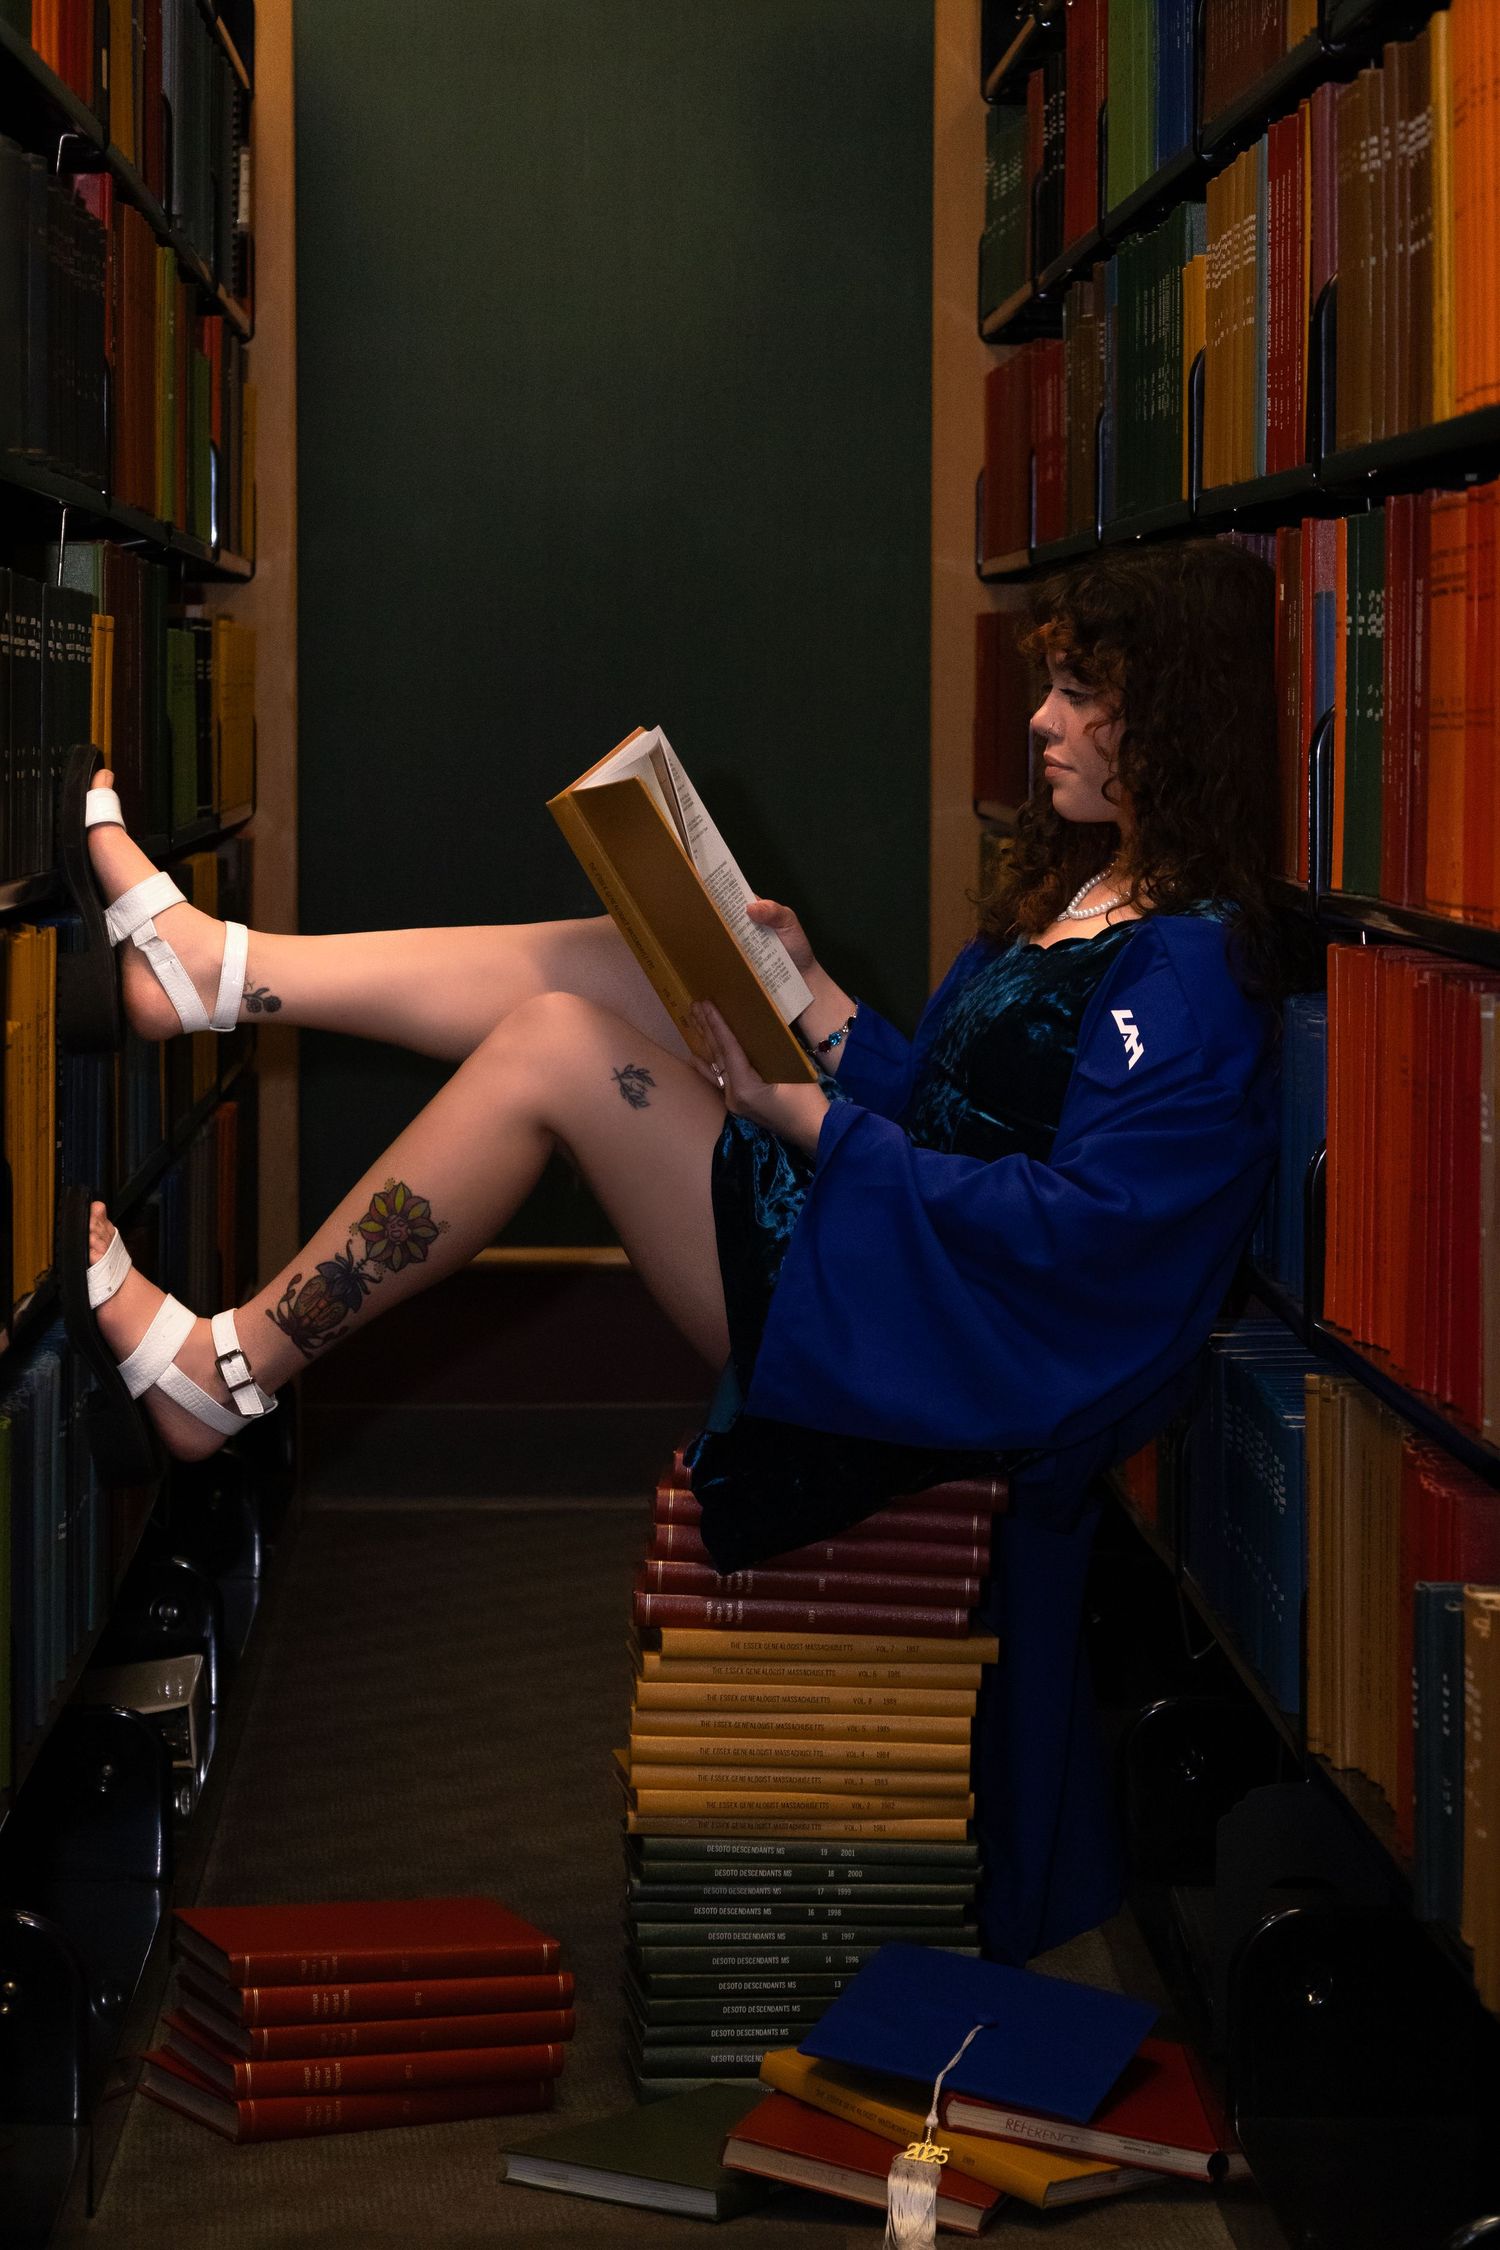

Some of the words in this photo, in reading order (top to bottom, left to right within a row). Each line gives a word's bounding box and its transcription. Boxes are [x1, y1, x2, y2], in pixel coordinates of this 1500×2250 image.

[731, 1642, 742, 1650] THE
[744, 1642, 762, 1650] ESSEX
[764, 1642, 803, 1651] GENEALOGIST
[804, 1643, 853, 1652] MASSACHUSETTS
[713, 1667, 724, 1675] THE
[707, 1695, 718, 1703] THE
[720, 1695, 738, 1703] ESSEX
[740, 1695, 780, 1704] GENEALOGIST
[781, 1696, 829, 1705] MASSACHUSETTS
[701, 1720, 712, 1729] THE
[700, 1748, 711, 1756] THE
[713, 1748, 731, 1756] ESSEX
[733, 1748, 772, 1757] GENEALOGIST
[773, 1749, 822, 1758] MASSACHUSETTS
[698, 1775, 709, 1783] THE
[706, 1801, 717, 1809] THE
[719, 1801, 738, 1809] ESSEX
[739, 1801, 779, 1809] GENEALOGIST
[780, 1801, 829, 1809] MASSACHUSETTS
[707, 1844, 730, 1853] DESOTO
[732, 1845, 774, 1855] DESCENDANTS
[776, 1847, 785, 1855] MS
[715, 1869, 738, 1877] DESOTO
[739, 1869, 782, 1877] DESCENDANTS
[783, 1869, 792, 1878] MS
[704, 1887, 727, 1895] DESOTO
[728, 1887, 771, 1895] DESCENDANTS
[772, 1887, 781, 1895] MS
[694, 1907, 717, 1915] DESOTO
[719, 1907, 761, 1916] DESCENDANTS
[762, 1908, 772, 1916] MS
[708, 1932, 731, 1940] DESOTO
[733, 1932, 775, 1940] DESCENDANTS
[776, 1932, 786, 1940] MS
[712, 1957, 736, 1965] DESOTO
[737, 1956, 780, 1965] DESCENDANTS
[781, 1956, 790, 1964] MS
[719, 1982, 742, 1990] DESOTO
[743, 1981, 786, 1990] DESCENDANTS
[787, 1981, 796, 1989] MS
[723, 2005, 746, 2014] DESOTO
[748, 2005, 790, 2013] DESCENDANTS
[791, 2005, 800, 2013] MS
[711, 2029, 734, 2037] DESOTO
[736, 2028, 778, 2037] DESCENDANTS
[780, 2028, 789, 2036] MS
[711, 2054, 734, 2063] DESOTO
[903, 2141, 950, 2165] 2025
